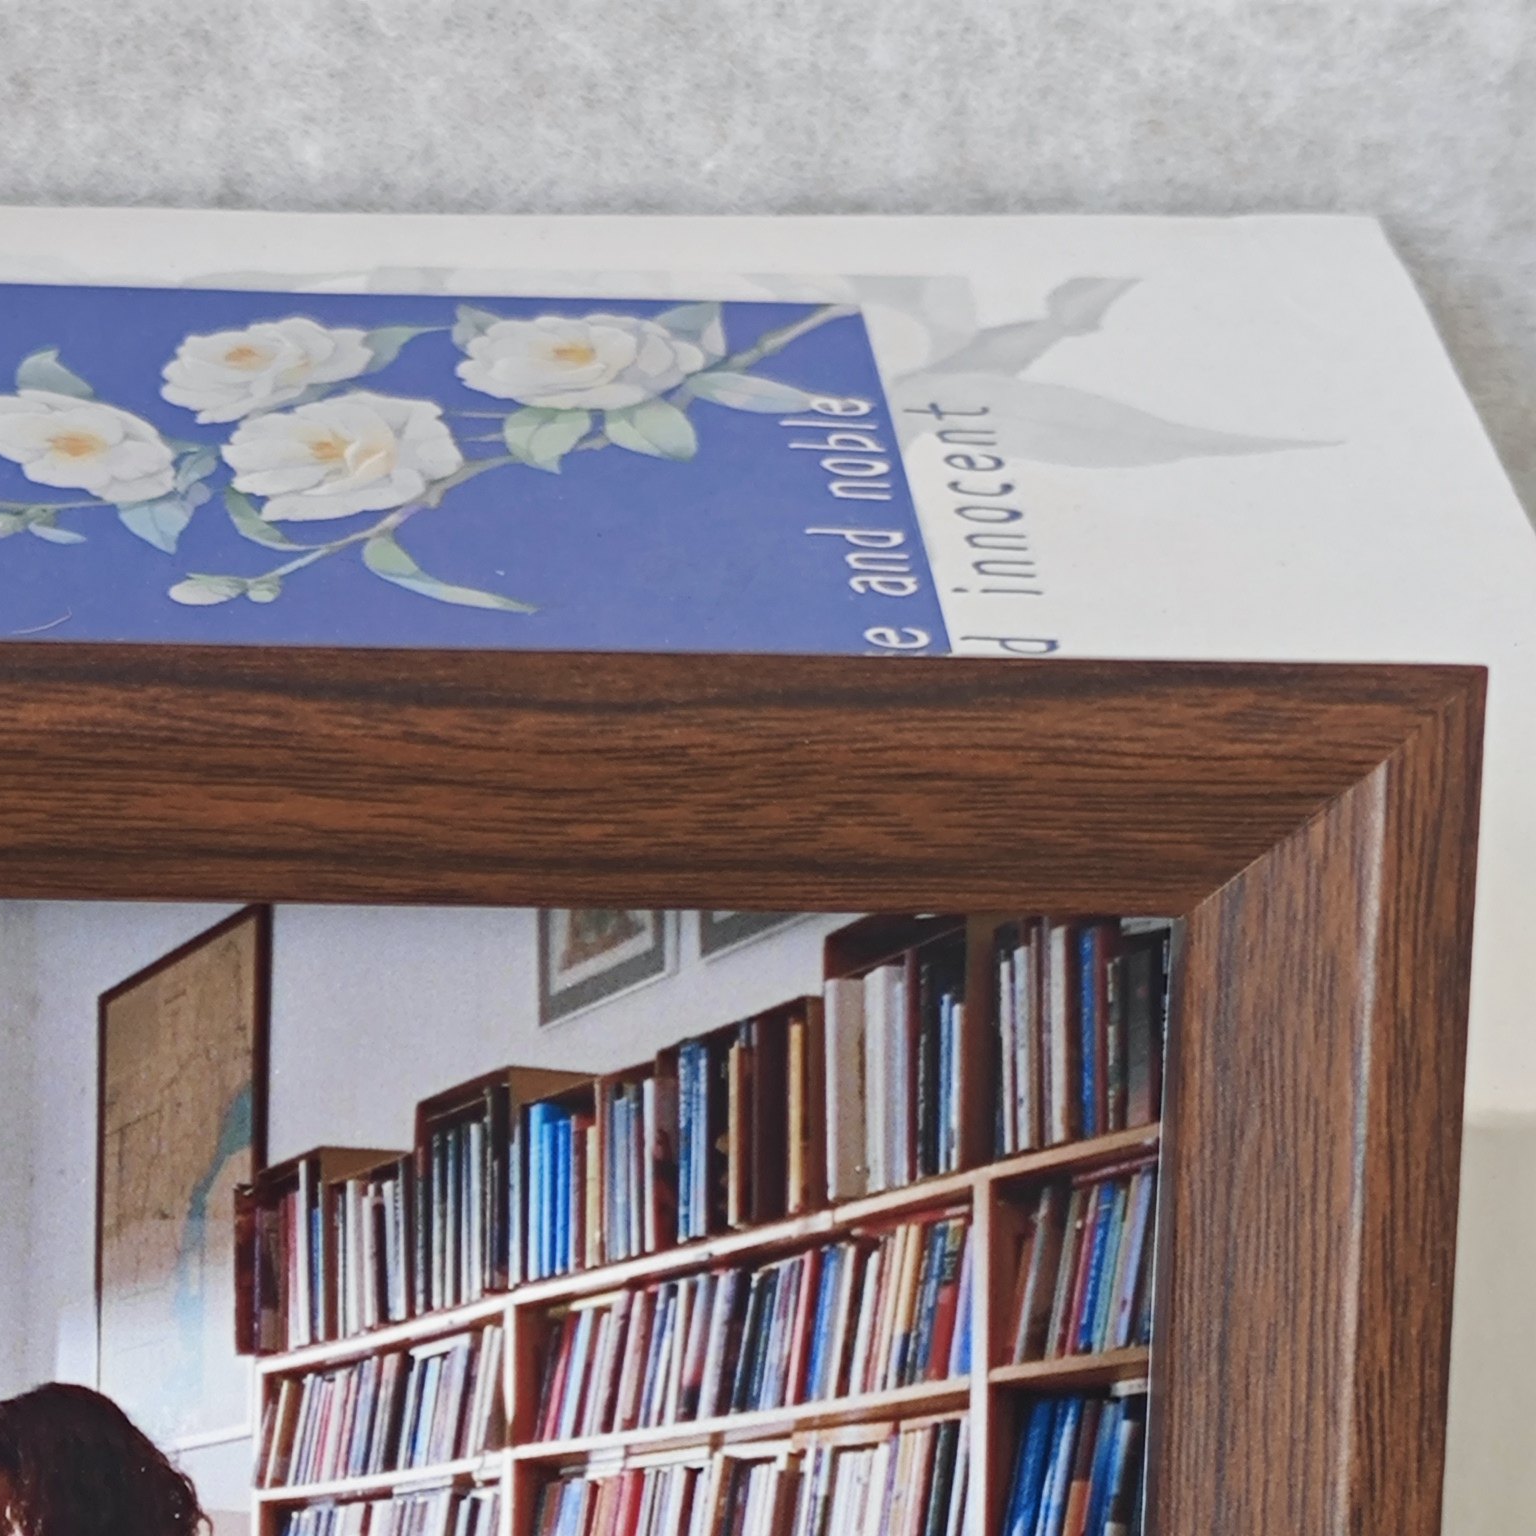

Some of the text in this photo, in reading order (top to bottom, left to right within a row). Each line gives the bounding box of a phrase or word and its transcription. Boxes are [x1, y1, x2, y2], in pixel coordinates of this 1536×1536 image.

[778, 396, 891, 500] noble
[901, 401, 1045, 595] innocent
[804, 527, 919, 597] and
